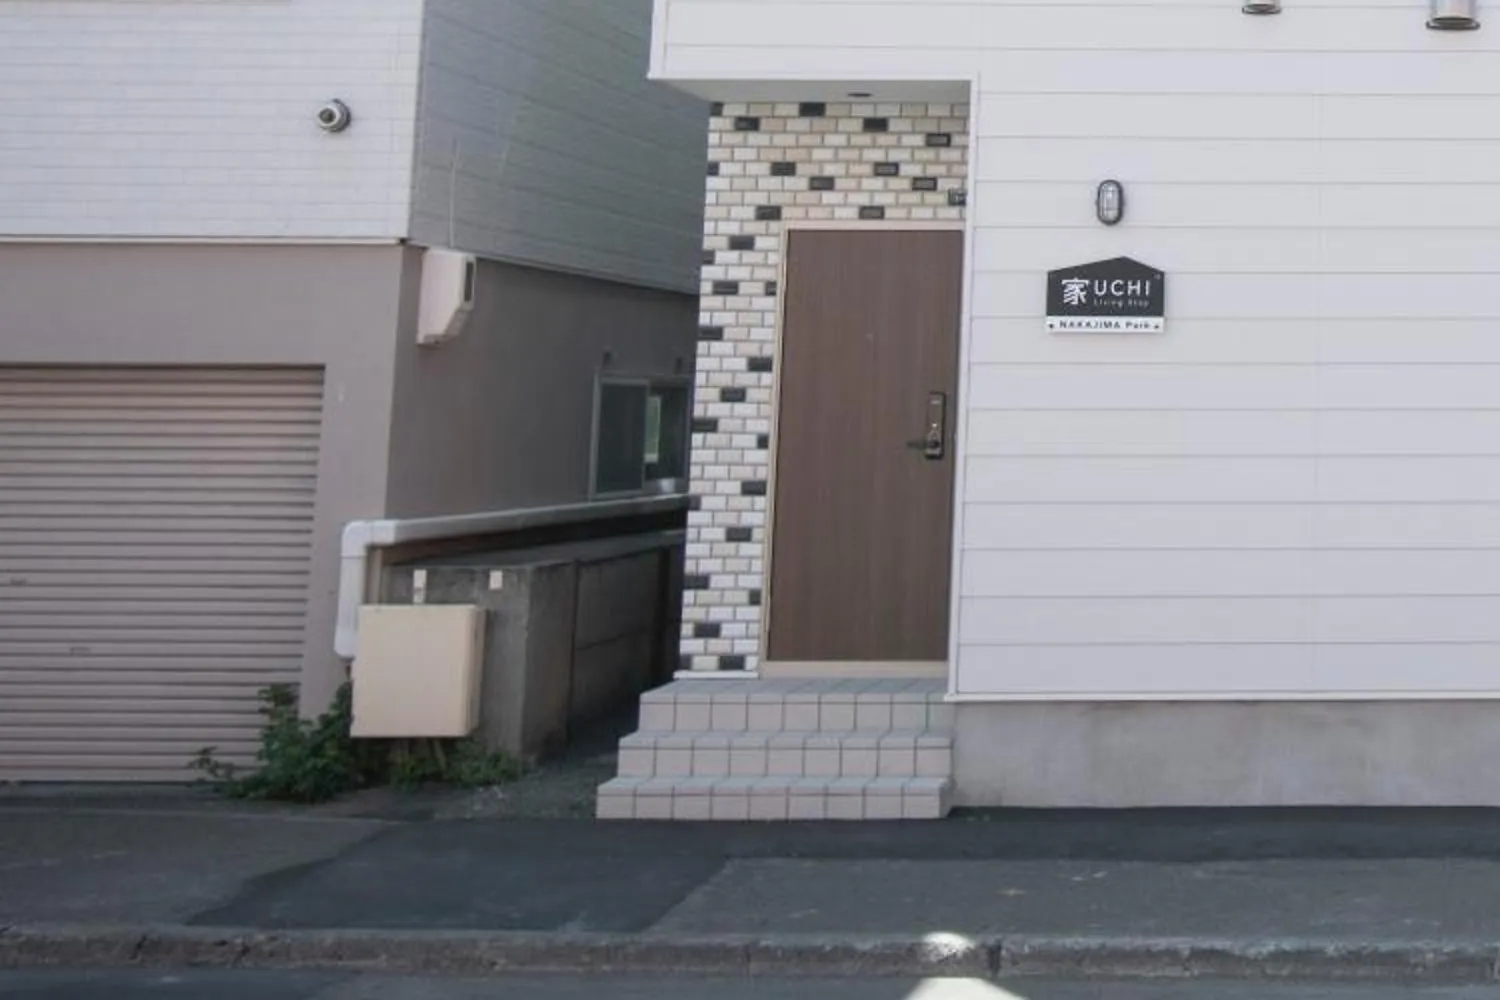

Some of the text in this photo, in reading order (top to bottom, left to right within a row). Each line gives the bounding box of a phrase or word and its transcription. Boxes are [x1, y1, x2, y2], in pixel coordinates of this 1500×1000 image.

[1061, 277, 1089, 305] 家
[1094, 279, 1151, 296] UCHI
[1059, 320, 1150, 329] NAKAJIMA Park
